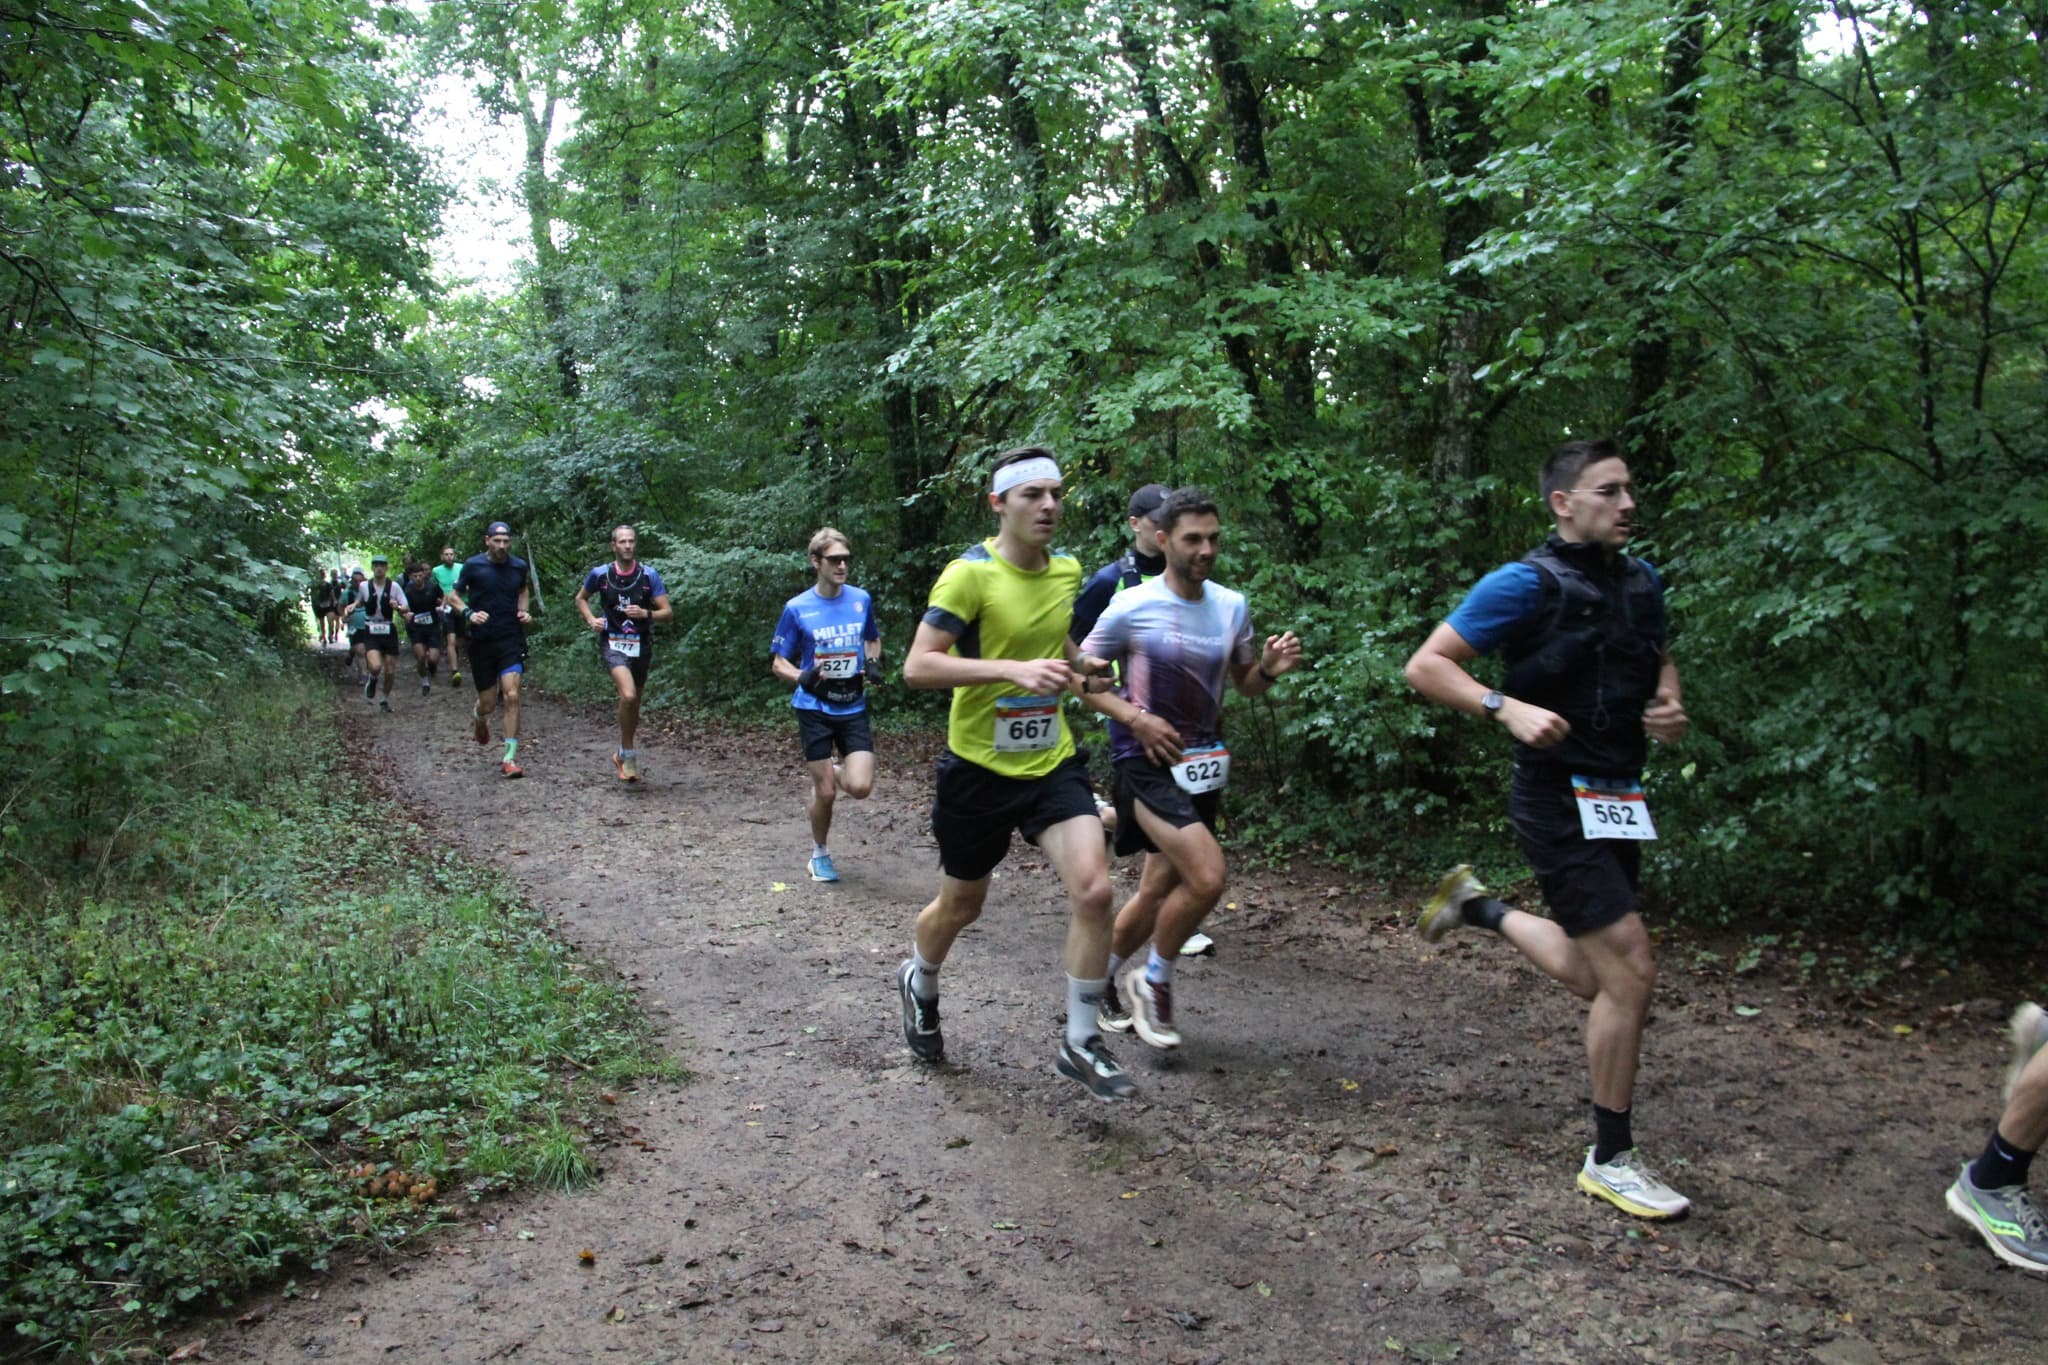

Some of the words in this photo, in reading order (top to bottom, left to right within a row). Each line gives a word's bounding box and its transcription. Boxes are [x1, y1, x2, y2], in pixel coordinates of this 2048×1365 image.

[813, 622, 863, 640] MILLET
[823, 659, 850, 671] 527
[1009, 718, 1052, 740] 667
[1186, 760, 1221, 782] 622
[1593, 803, 1639, 825] 562
